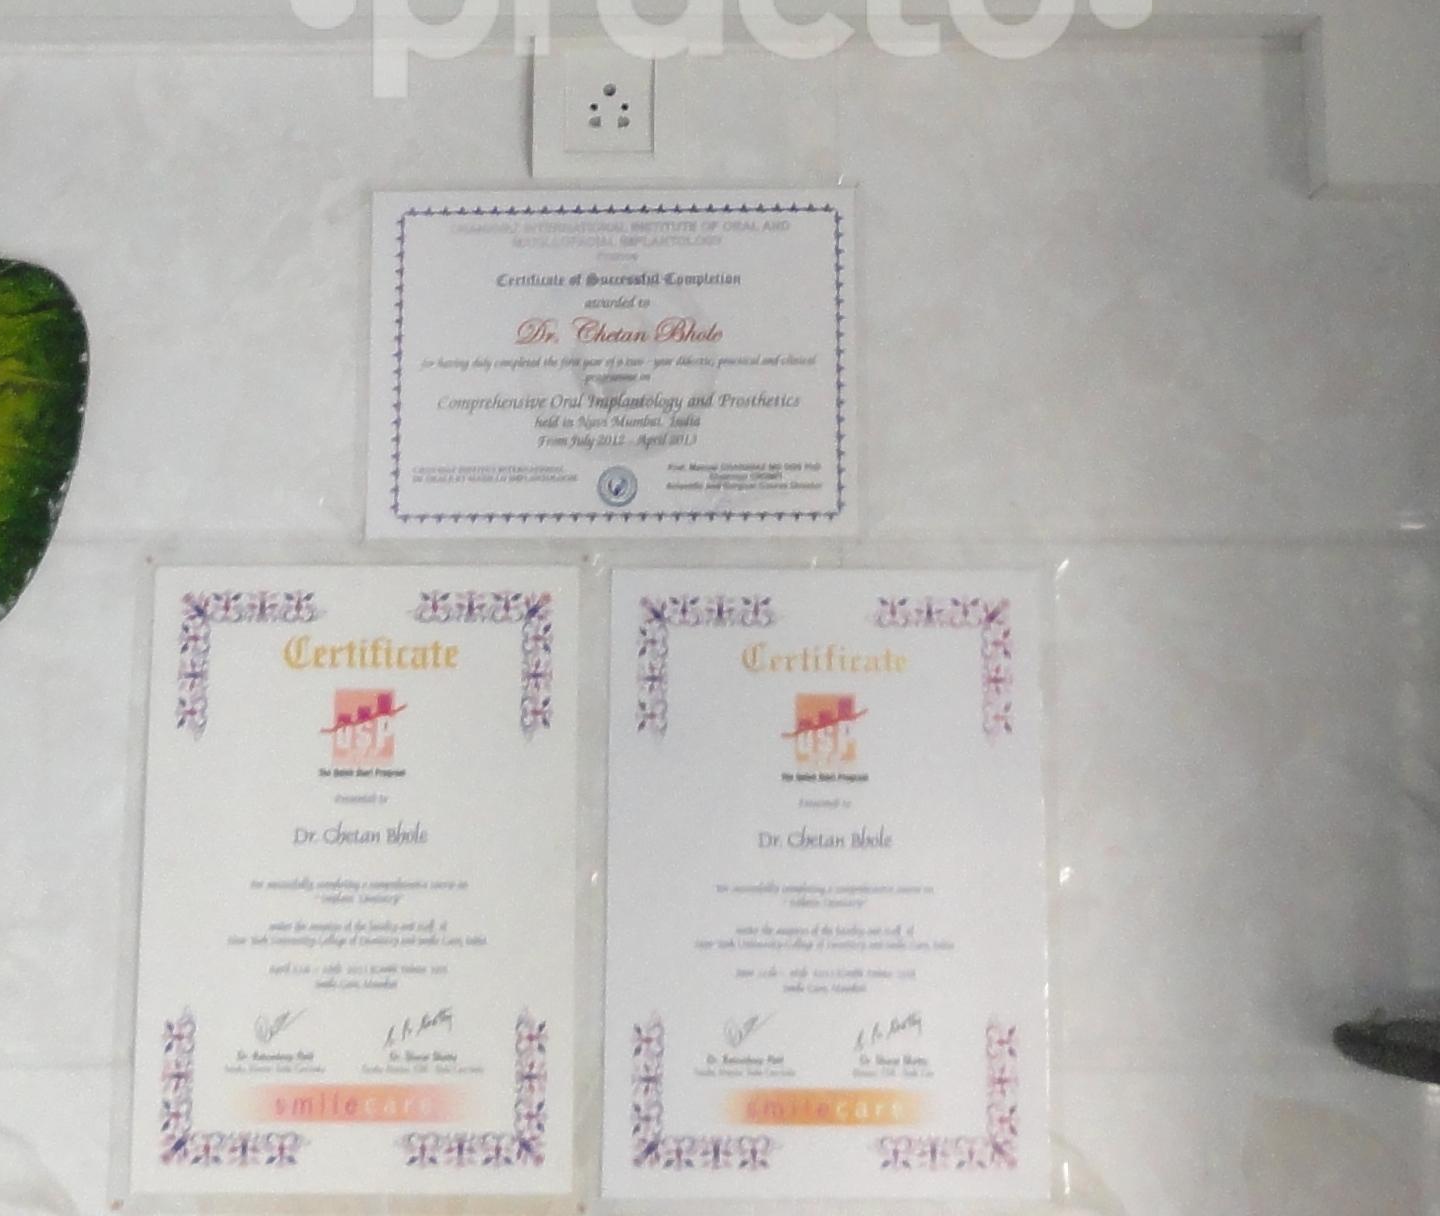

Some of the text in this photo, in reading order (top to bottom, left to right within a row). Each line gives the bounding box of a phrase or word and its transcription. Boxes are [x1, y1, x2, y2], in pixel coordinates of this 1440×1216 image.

[496, 273, 564, 287] Certificate
[585, 272, 660, 287] Successful
[664, 272, 741, 288] Completion
[514, 317, 724, 345] Dr. Chetan Bhole
[436, 390, 801, 416] Comprehensive Oral Implantology and Prosthetics
[282, 634, 459, 671] Certificate
[740, 641, 910, 673] Certificate
[292, 820, 428, 846] Dr. Chetan Bhole
[757, 825, 893, 849] Dr. Chetan Bhole
